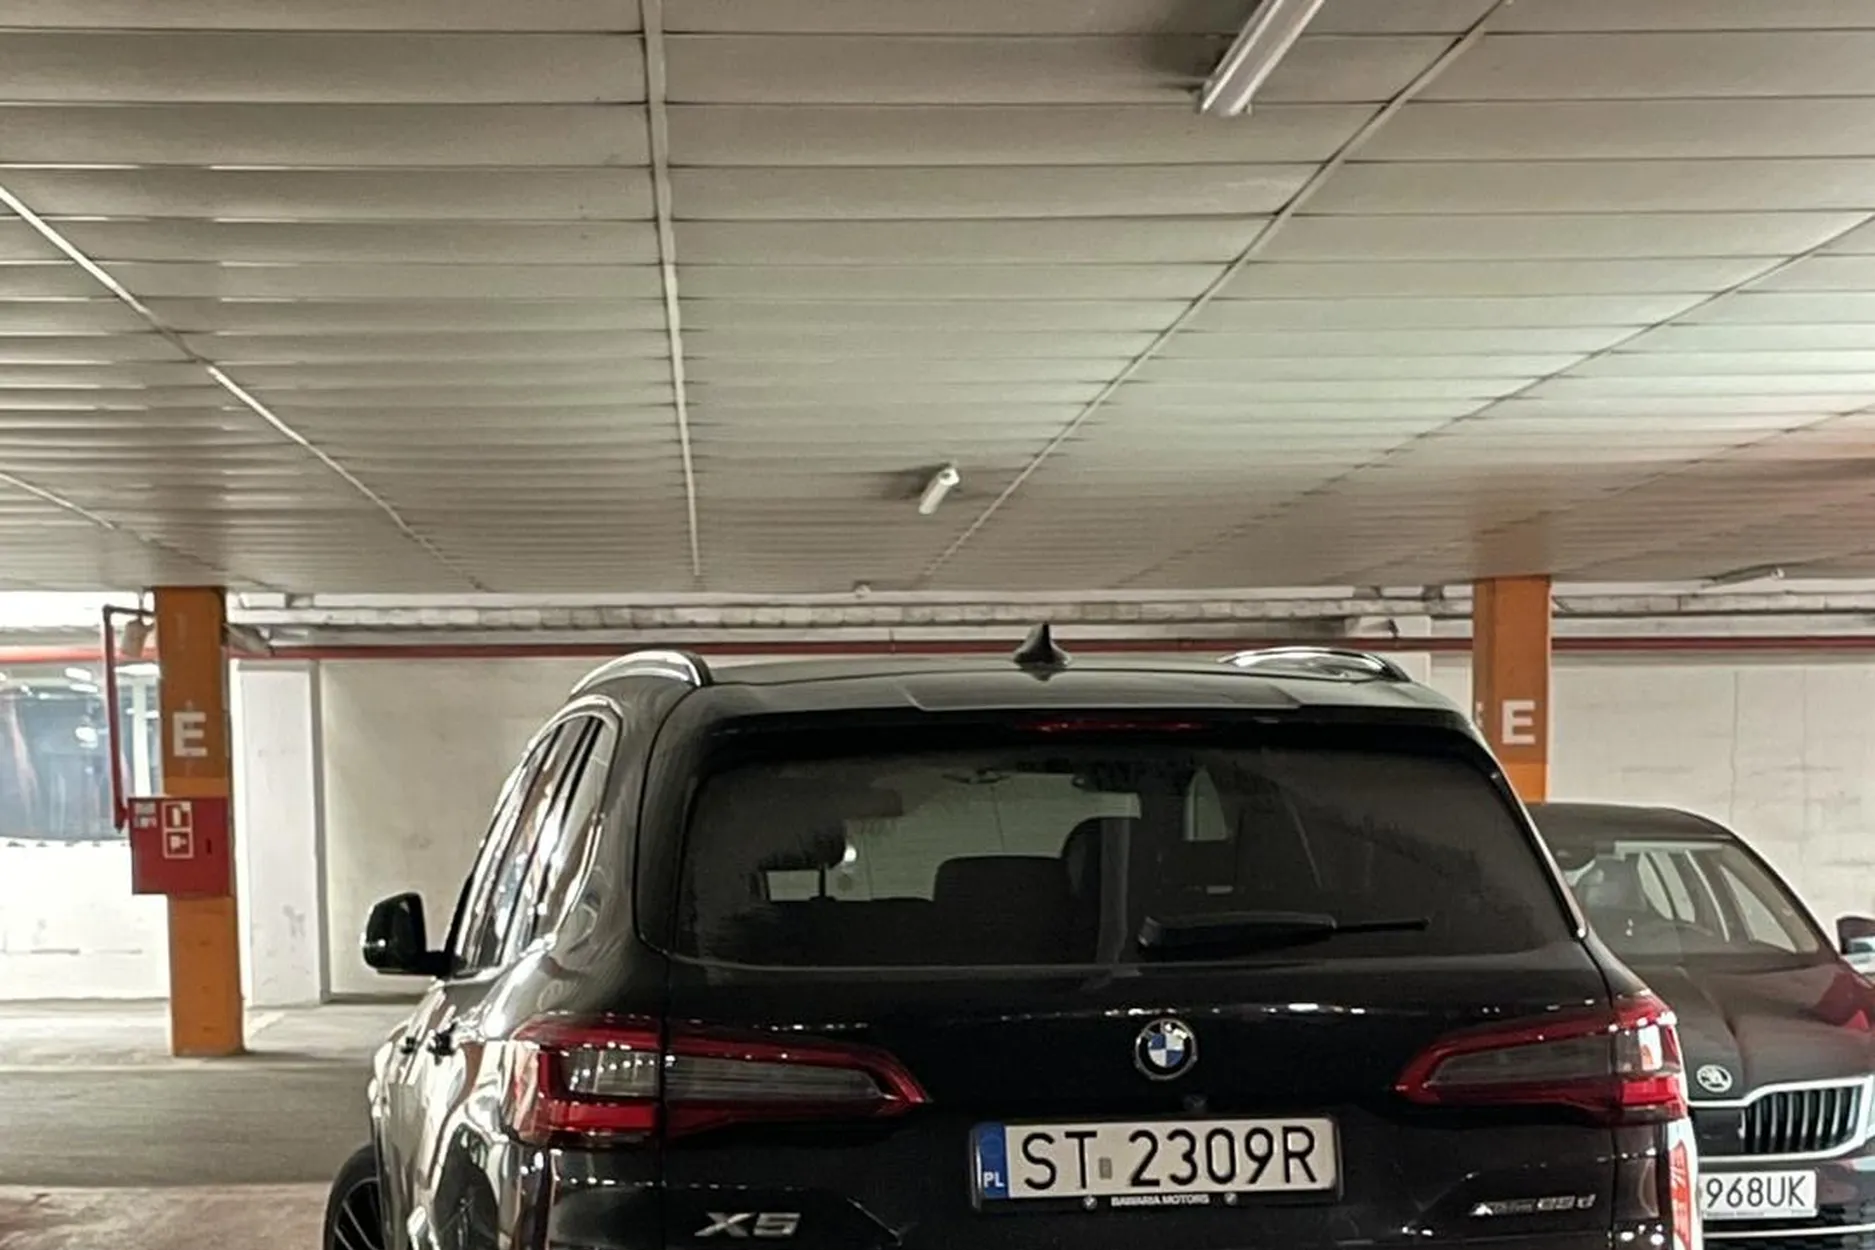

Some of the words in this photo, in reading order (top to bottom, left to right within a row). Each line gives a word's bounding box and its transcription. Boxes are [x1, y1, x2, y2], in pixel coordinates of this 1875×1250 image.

[173, 711, 208, 757] E
[1502, 700, 1536, 744] E
[1021, 1131, 1098, 1190] ST
[1128, 1126, 1317, 1187] 2309R
[983, 1171, 1005, 1188] PL
[1706, 1175, 1806, 1208] 968UK
[694, 1212, 801, 1237] X5
